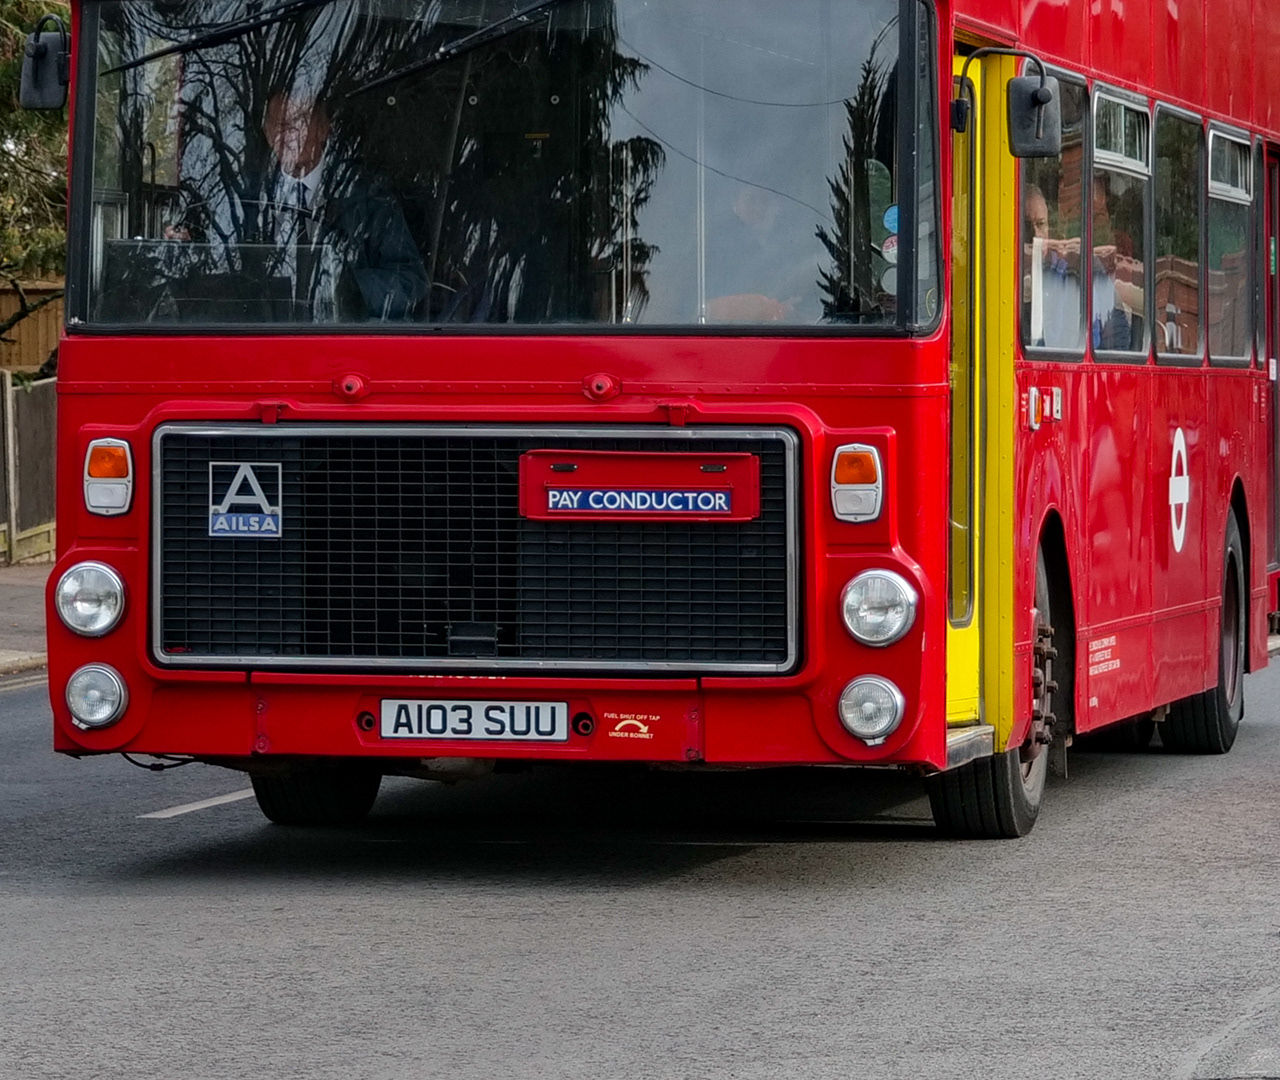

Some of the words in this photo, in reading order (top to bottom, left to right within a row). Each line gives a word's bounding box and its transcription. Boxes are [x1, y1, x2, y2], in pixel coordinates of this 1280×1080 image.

[548, 491, 582, 509] PAY
[588, 491, 728, 510] CONDUCTOR
[213, 516, 277, 531] AILSA
[393, 704, 472, 735] A103
[484, 705, 556, 736] SUU
